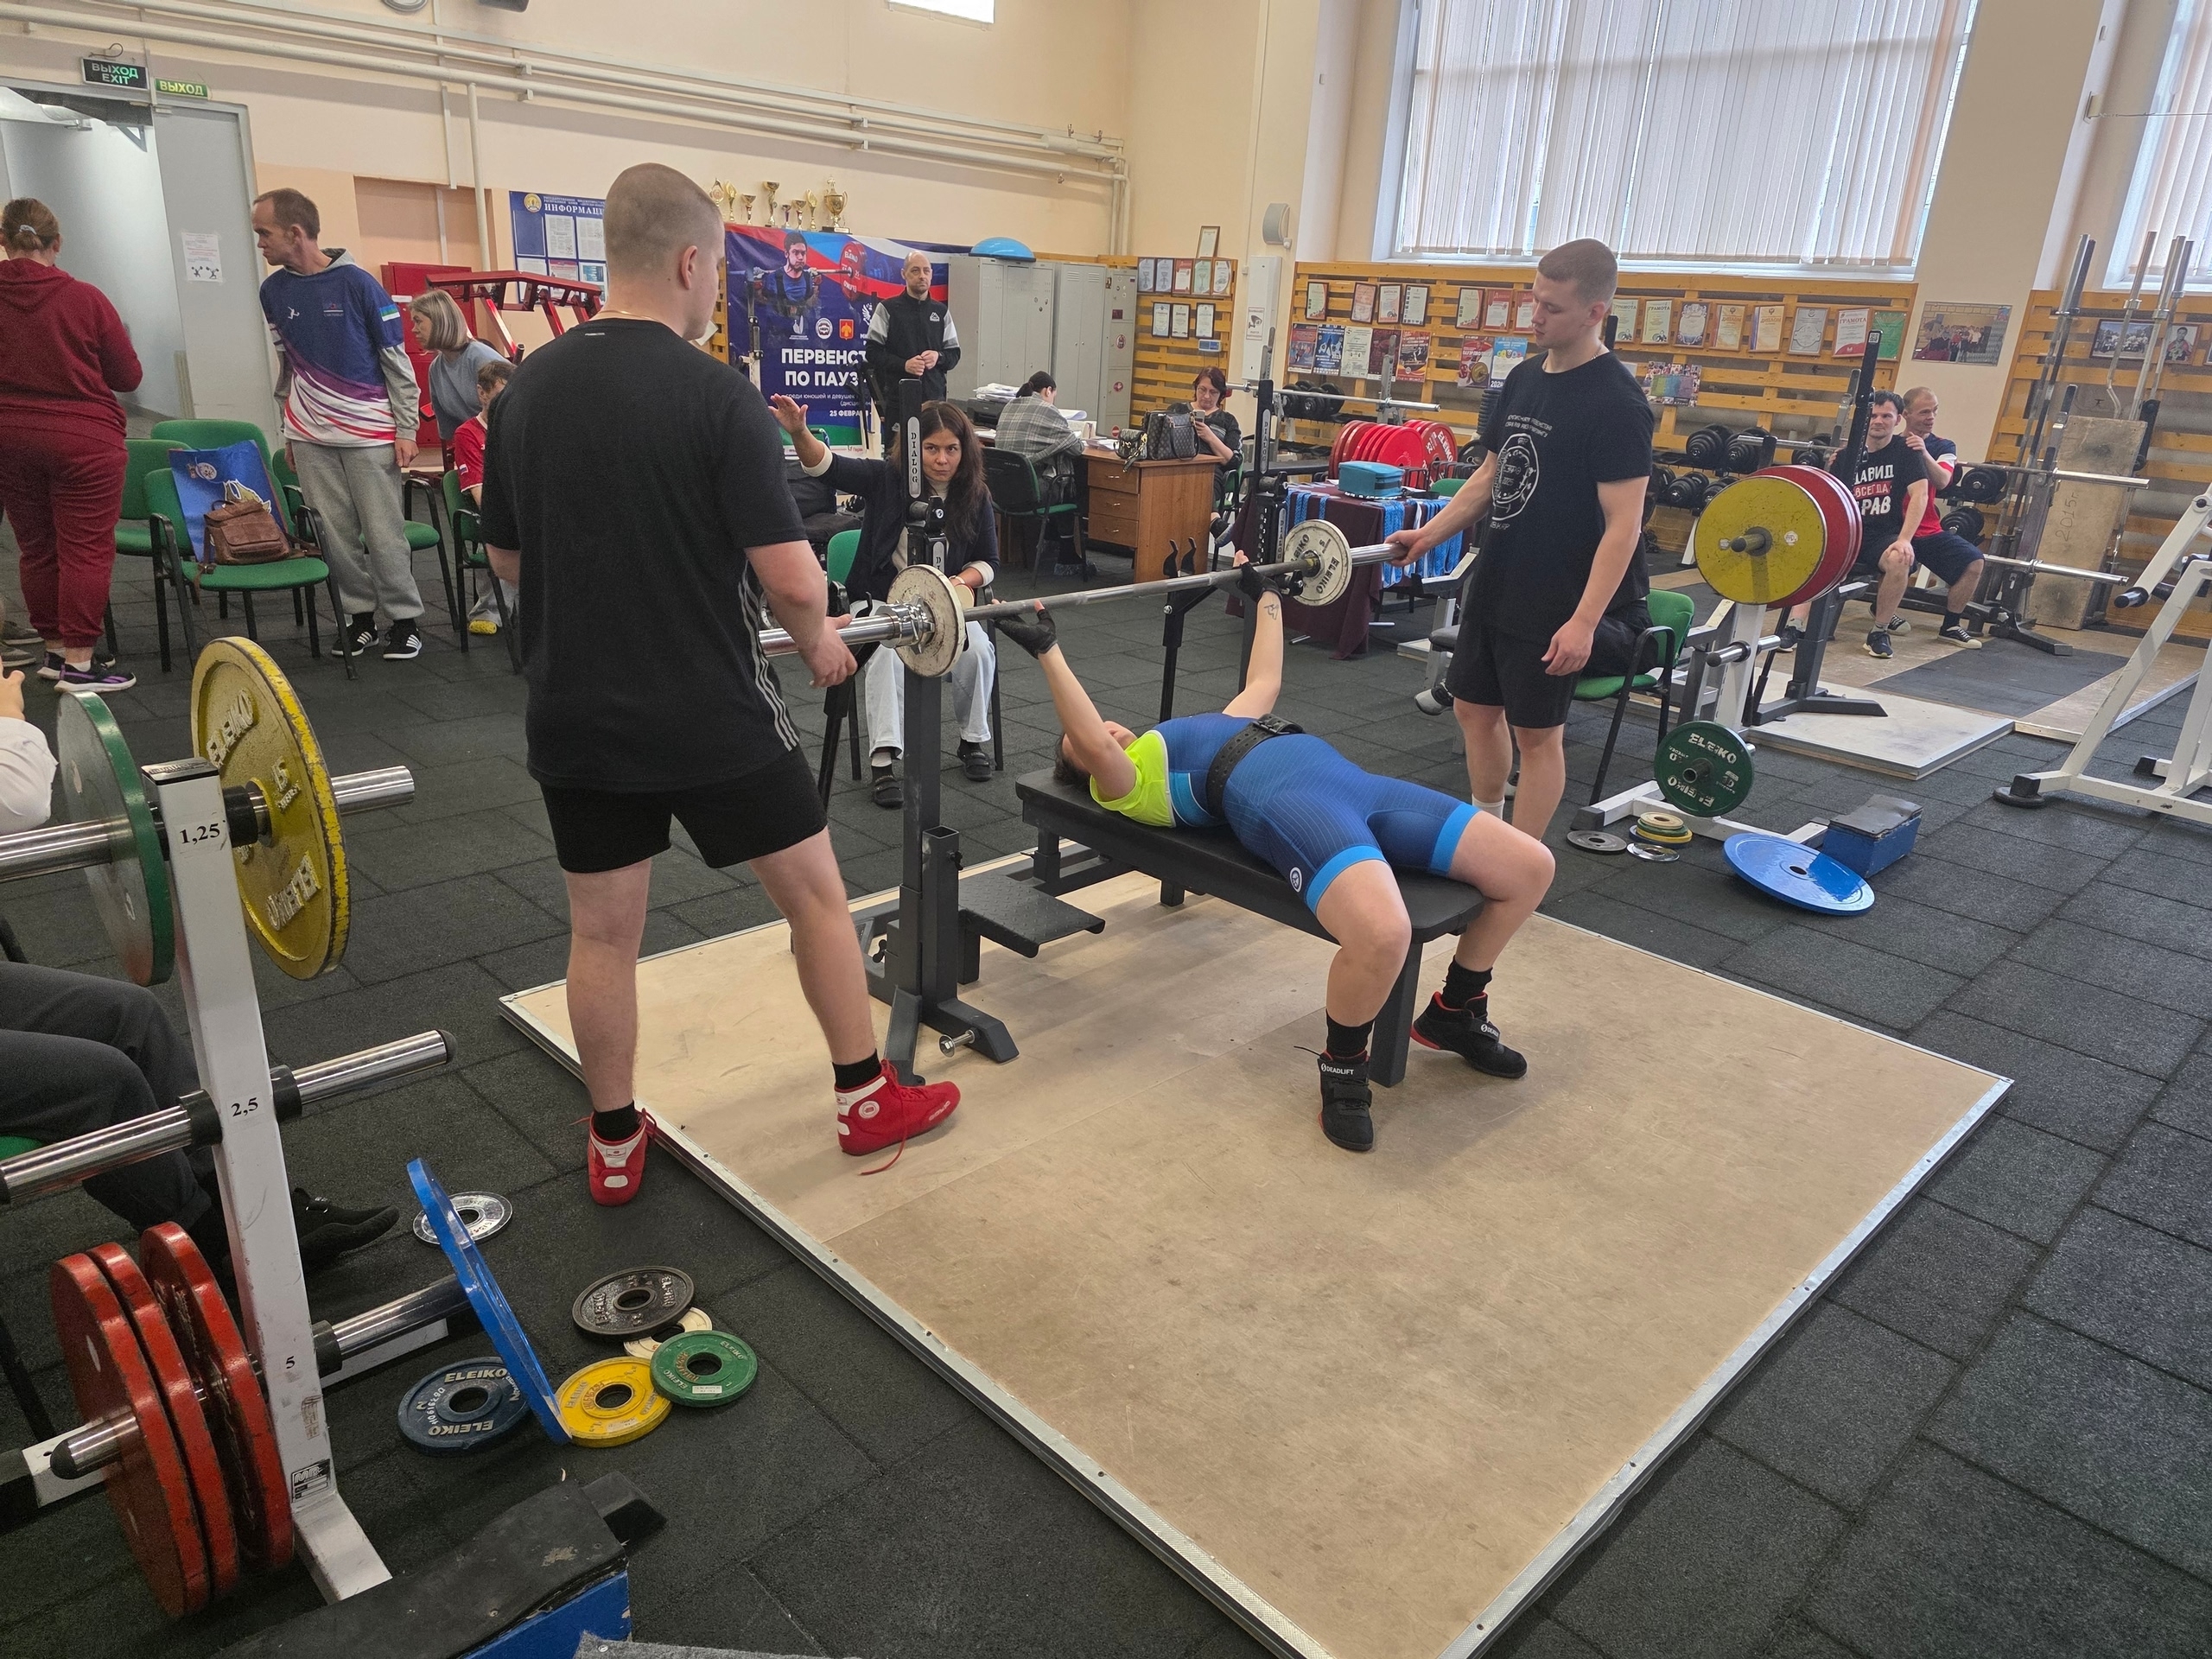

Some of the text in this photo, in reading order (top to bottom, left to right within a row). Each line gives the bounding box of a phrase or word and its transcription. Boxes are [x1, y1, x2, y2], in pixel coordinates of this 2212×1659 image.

[92, 63, 139, 79] ВЫХОД
[102, 73, 130, 85] EXIT
[159, 80, 204, 96] ВЫХОД
[544, 203, 603, 215] ИНФОРМАЦ
[781, 348, 868, 365] ПЕРВЕНСТ
[785, 371, 810, 386] ПО
[1438, 430, 1453, 462] ELEIKO
[1855, 484, 1889, 498] ВСЕГДА
[1857, 496, 1891, 516] РАВ
[1316, 556, 1340, 594] ELEIKO
[207, 689, 254, 769] ELEIKO
[1688, 733, 1737, 764] ELEIKO
[180, 823, 220, 845] 1,25
[1326, 1065, 1354, 1075] DEADLIFT
[231, 1097, 258, 1117] 2,5
[719, 1341, 744, 1360] ELEIKO
[286, 1356, 296, 1370] 5
[444, 1368, 508, 1383] ELEIKO
[664, 1369, 689, 1390] ELEIKO
[428, 1420, 494, 1436] ELEIKO
